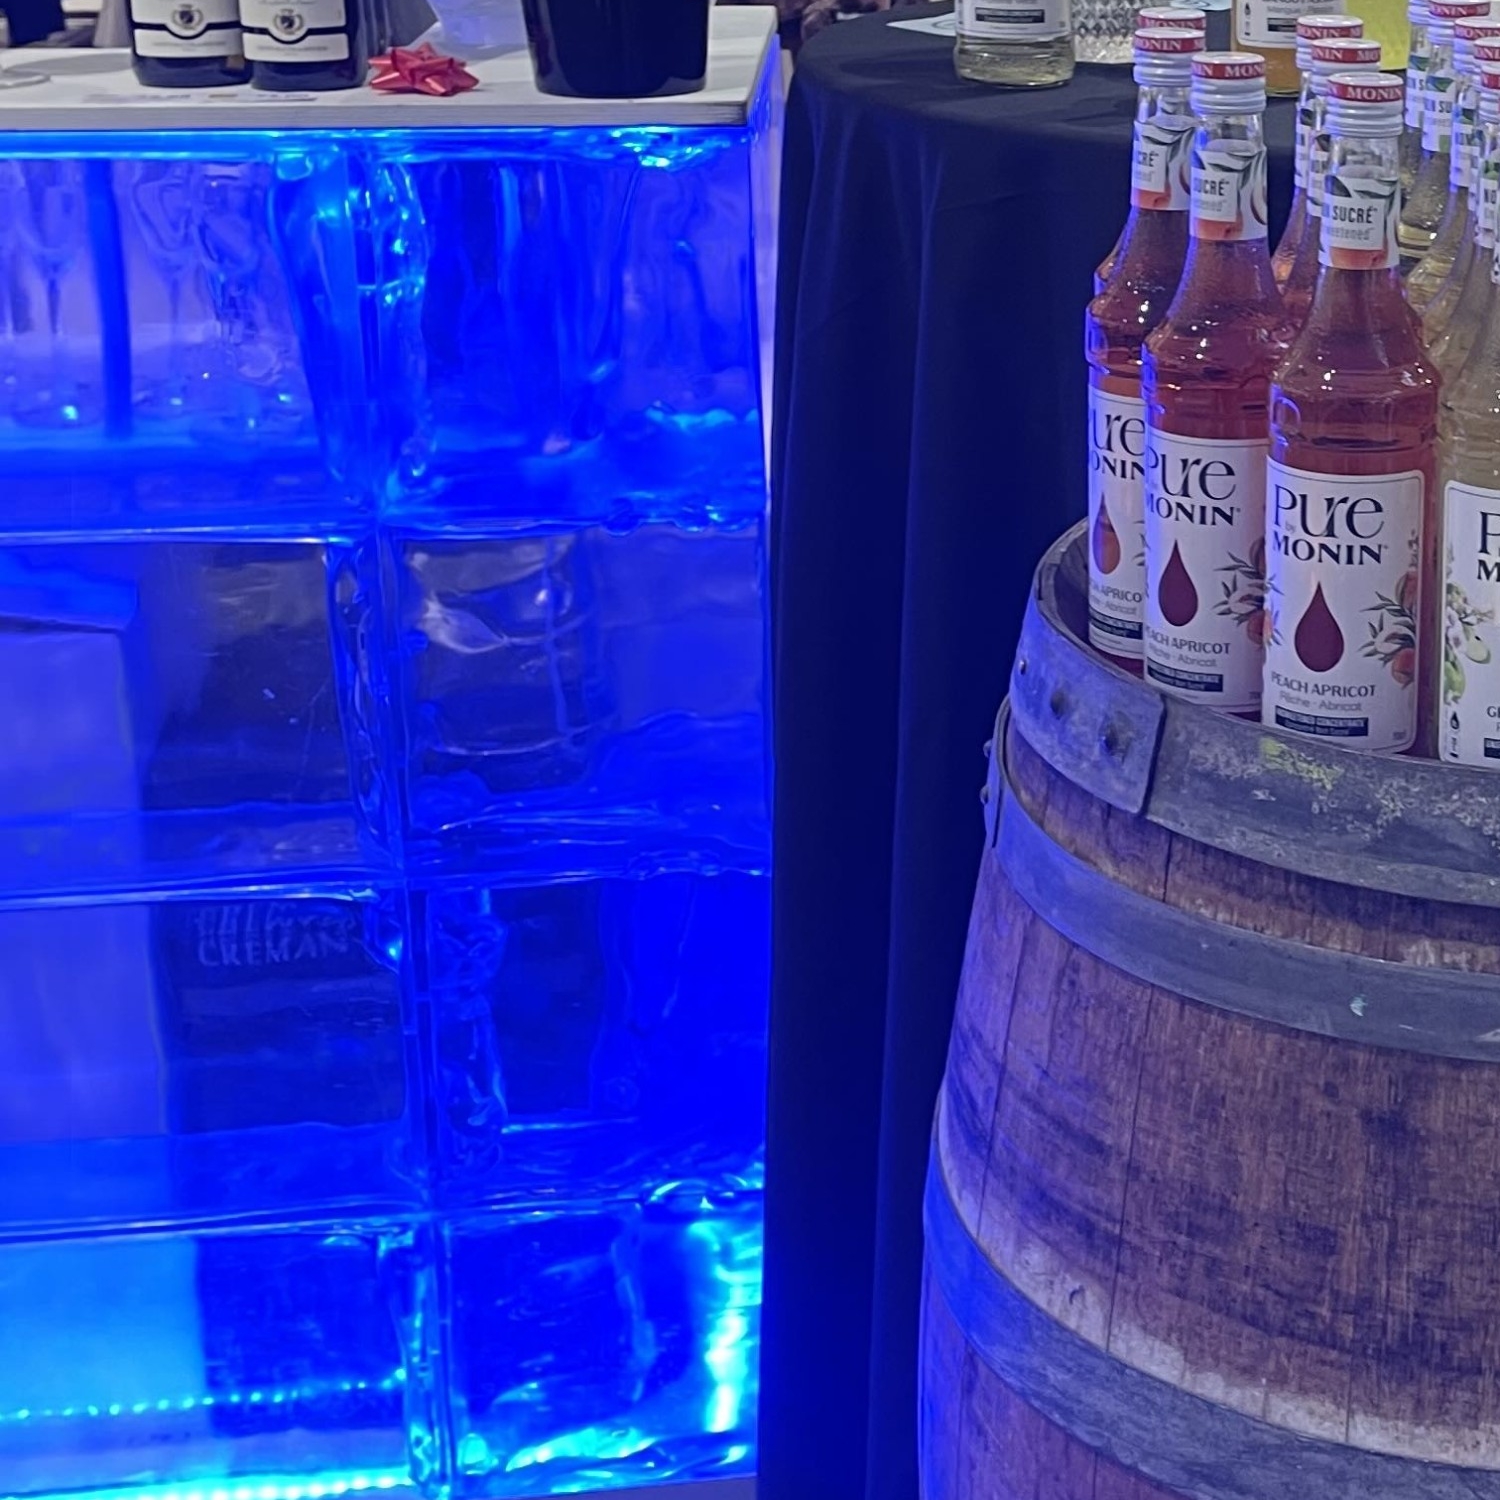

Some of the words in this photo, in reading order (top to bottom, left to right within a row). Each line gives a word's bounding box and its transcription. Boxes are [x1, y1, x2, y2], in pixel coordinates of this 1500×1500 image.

[1332, 206, 1373, 223] SUCRÉ
[1274, 483, 1384, 540] Pure
[1272, 532, 1383, 566] MONIN
[1171, 638, 1231, 655] APRICOT
[1271, 670, 1309, 694] PEACH
[1311, 683, 1376, 698] APRICOT
